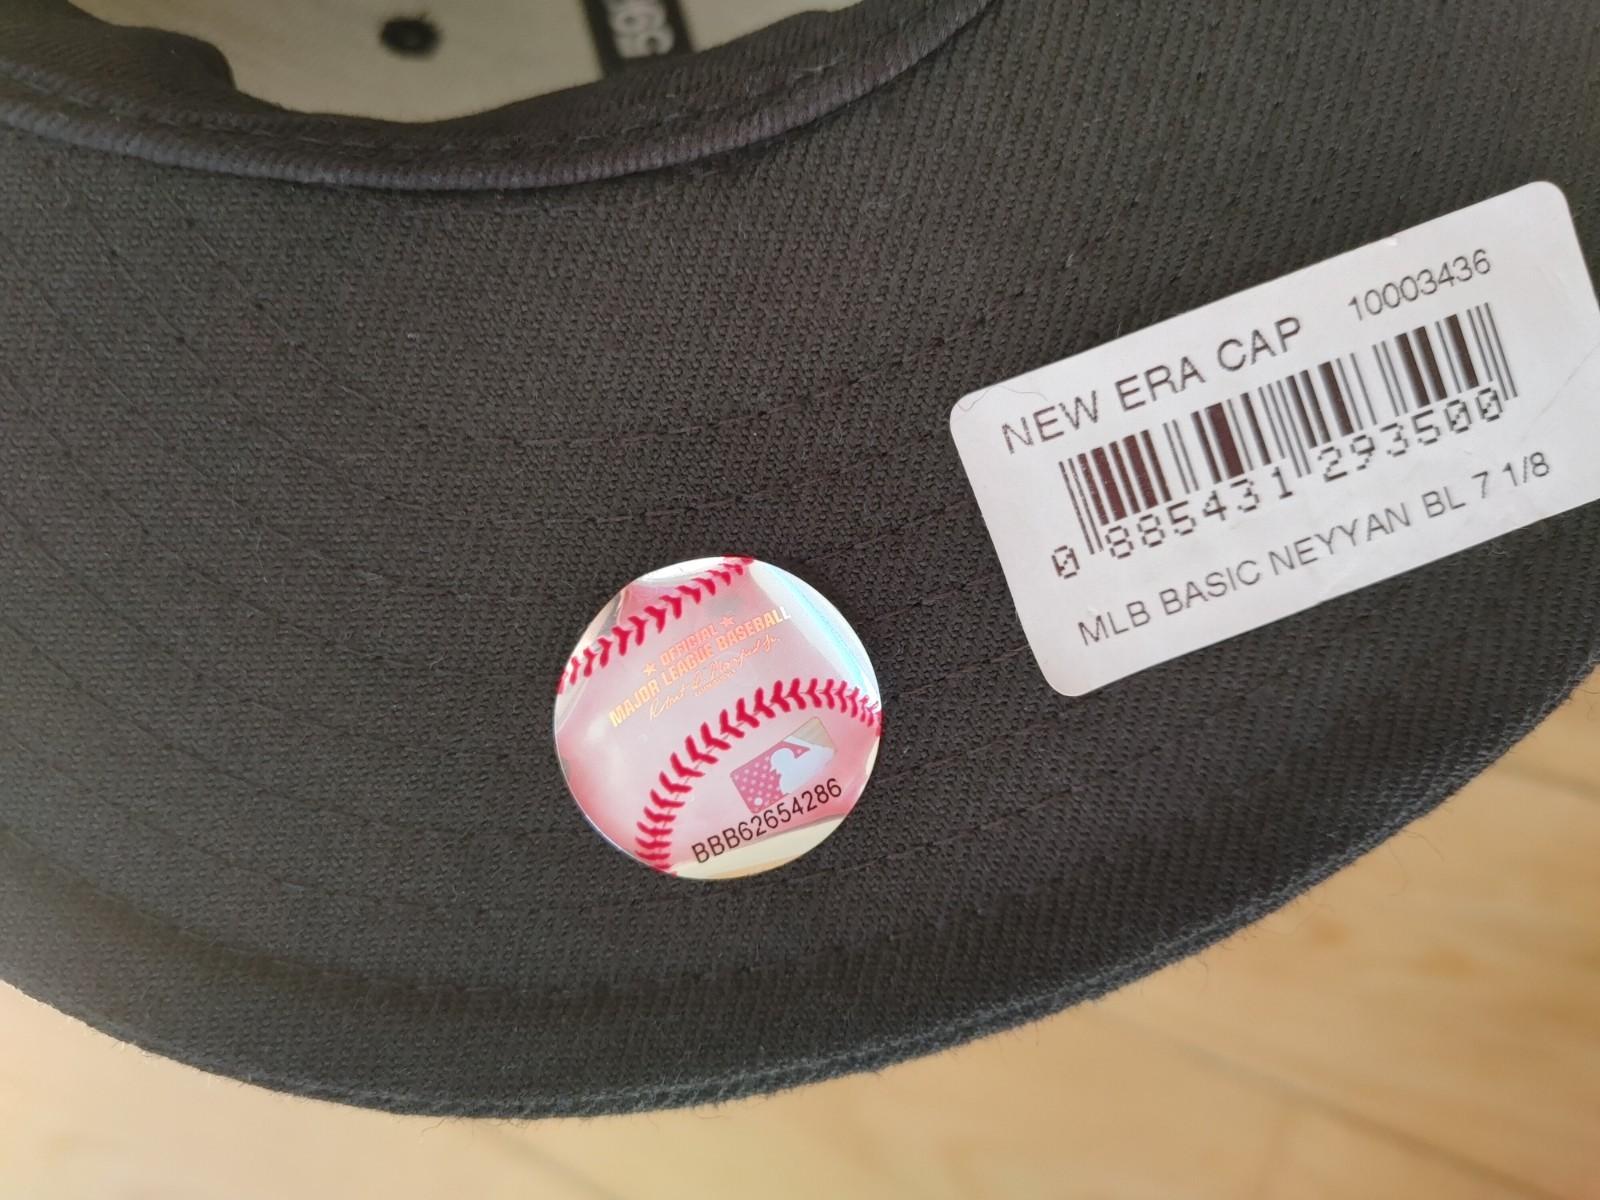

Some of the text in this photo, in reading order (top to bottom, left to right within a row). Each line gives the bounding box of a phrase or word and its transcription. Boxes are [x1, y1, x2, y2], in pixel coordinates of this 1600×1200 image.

[1347, 248, 1492, 321] 10003436
[1001, 316, 1302, 454] NEW ERA CAP
[1104, 466, 1293, 559] 885431
[1317, 386, 1504, 483] 293500
[1077, 451, 1550, 647] MLB BASIC NEYYAN BL 7 1/8
[608, 679, 661, 728] MAJOR
[661, 643, 714, 686] LEAGUE
[715, 605, 792, 652] BASEBALL
[659, 623, 719, 667] OFFICIAL
[690, 776, 843, 864] BBB62654286
